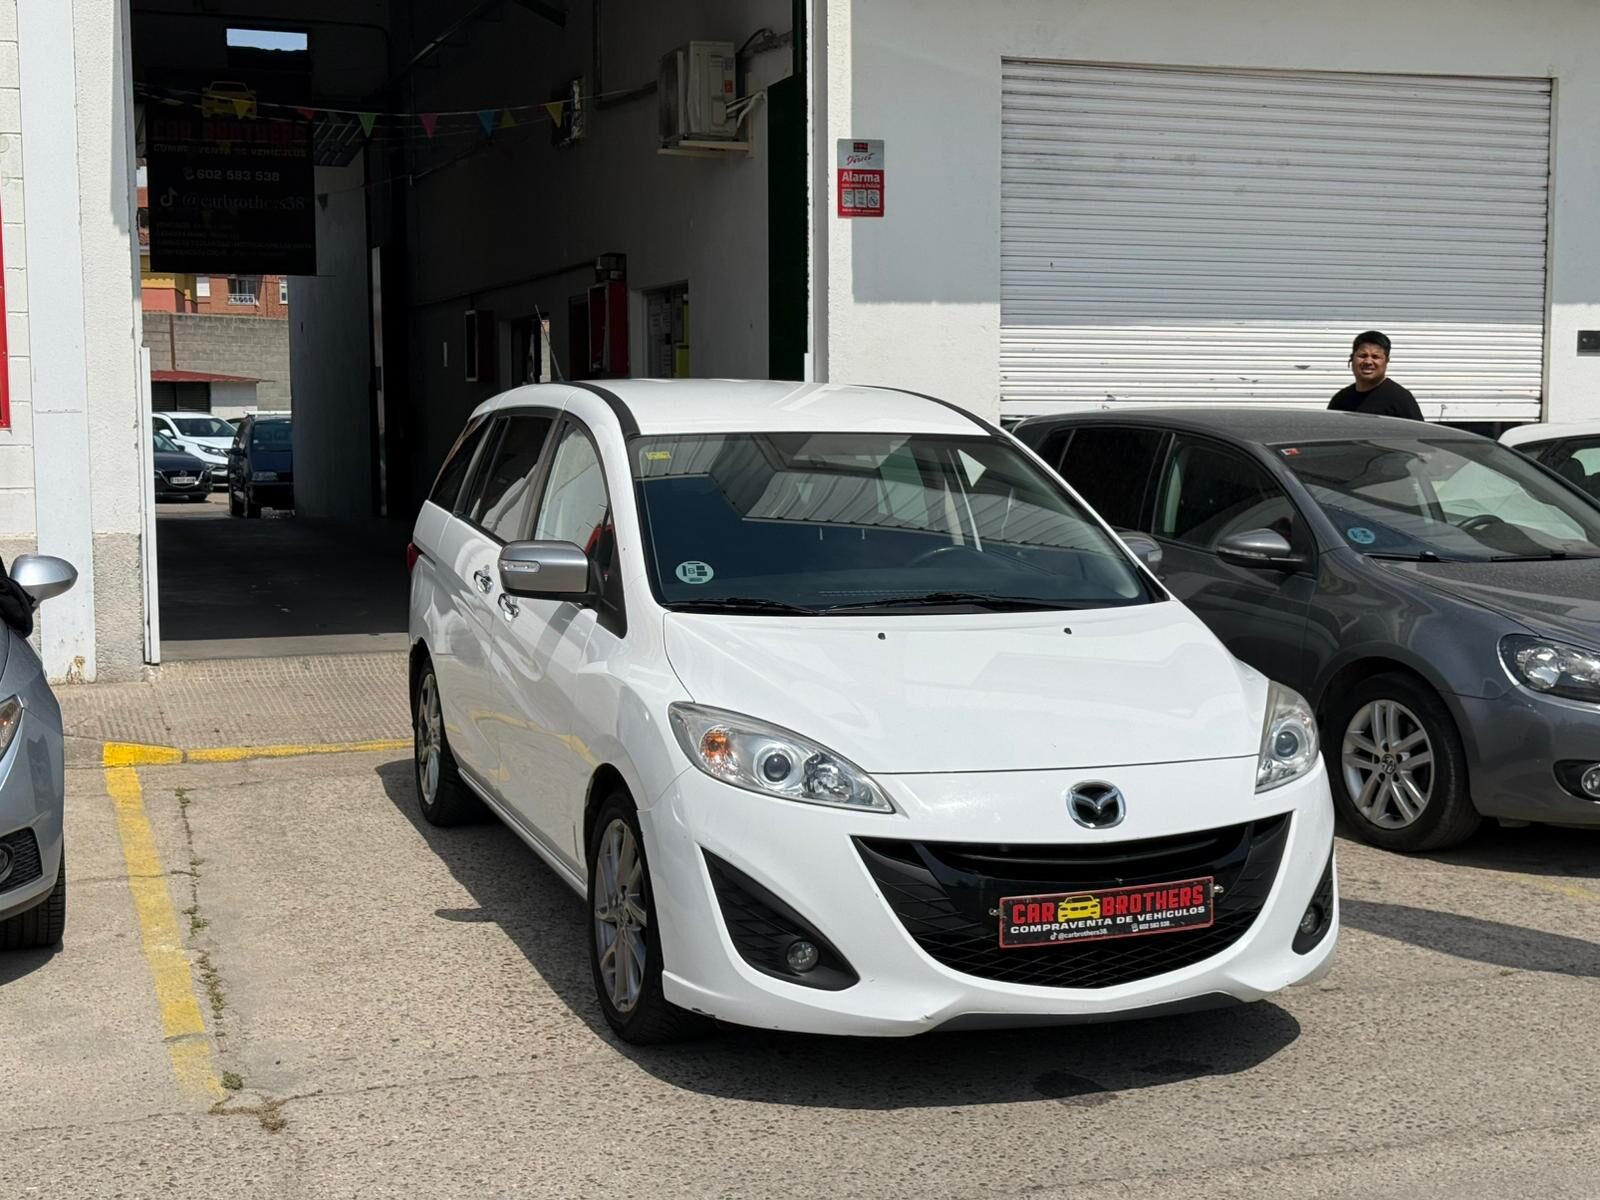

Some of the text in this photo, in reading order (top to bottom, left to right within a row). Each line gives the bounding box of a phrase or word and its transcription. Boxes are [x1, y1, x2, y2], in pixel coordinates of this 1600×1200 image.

[196, 168, 222, 181] 602
[255, 170, 281, 182] 538
[842, 171, 880, 183] Alarma
[1012, 885, 1205, 924] CAR BROTHERS
[1010, 905, 1205, 934] COMPRAVENTA DE VEHÍCULOS
[1057, 928, 1108, 940] @carbrothers38
